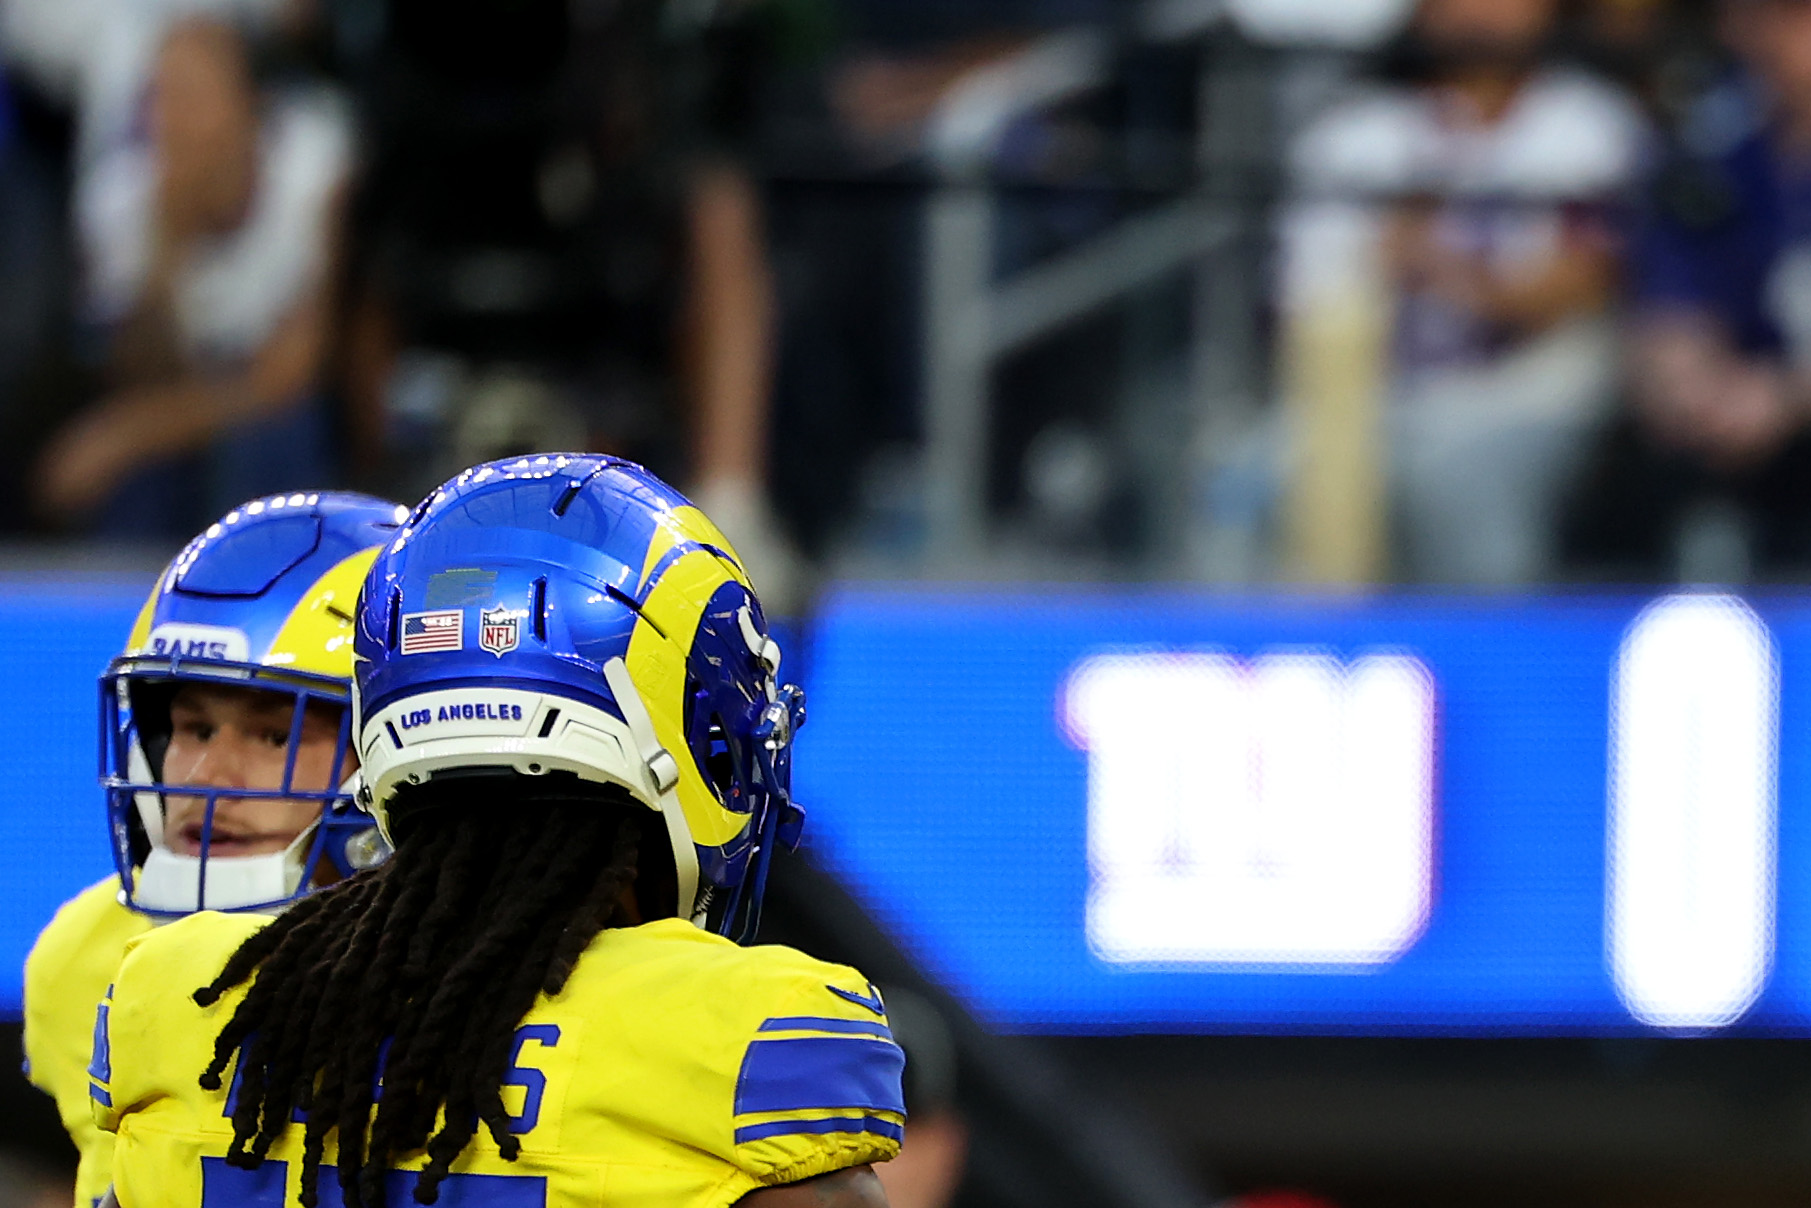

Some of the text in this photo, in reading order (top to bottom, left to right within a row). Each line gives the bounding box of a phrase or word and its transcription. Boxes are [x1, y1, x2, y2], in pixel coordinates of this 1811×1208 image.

[153, 637, 228, 660] RAMS
[485, 627, 514, 648] NFL
[401, 703, 523, 729] LOS ANGELES
